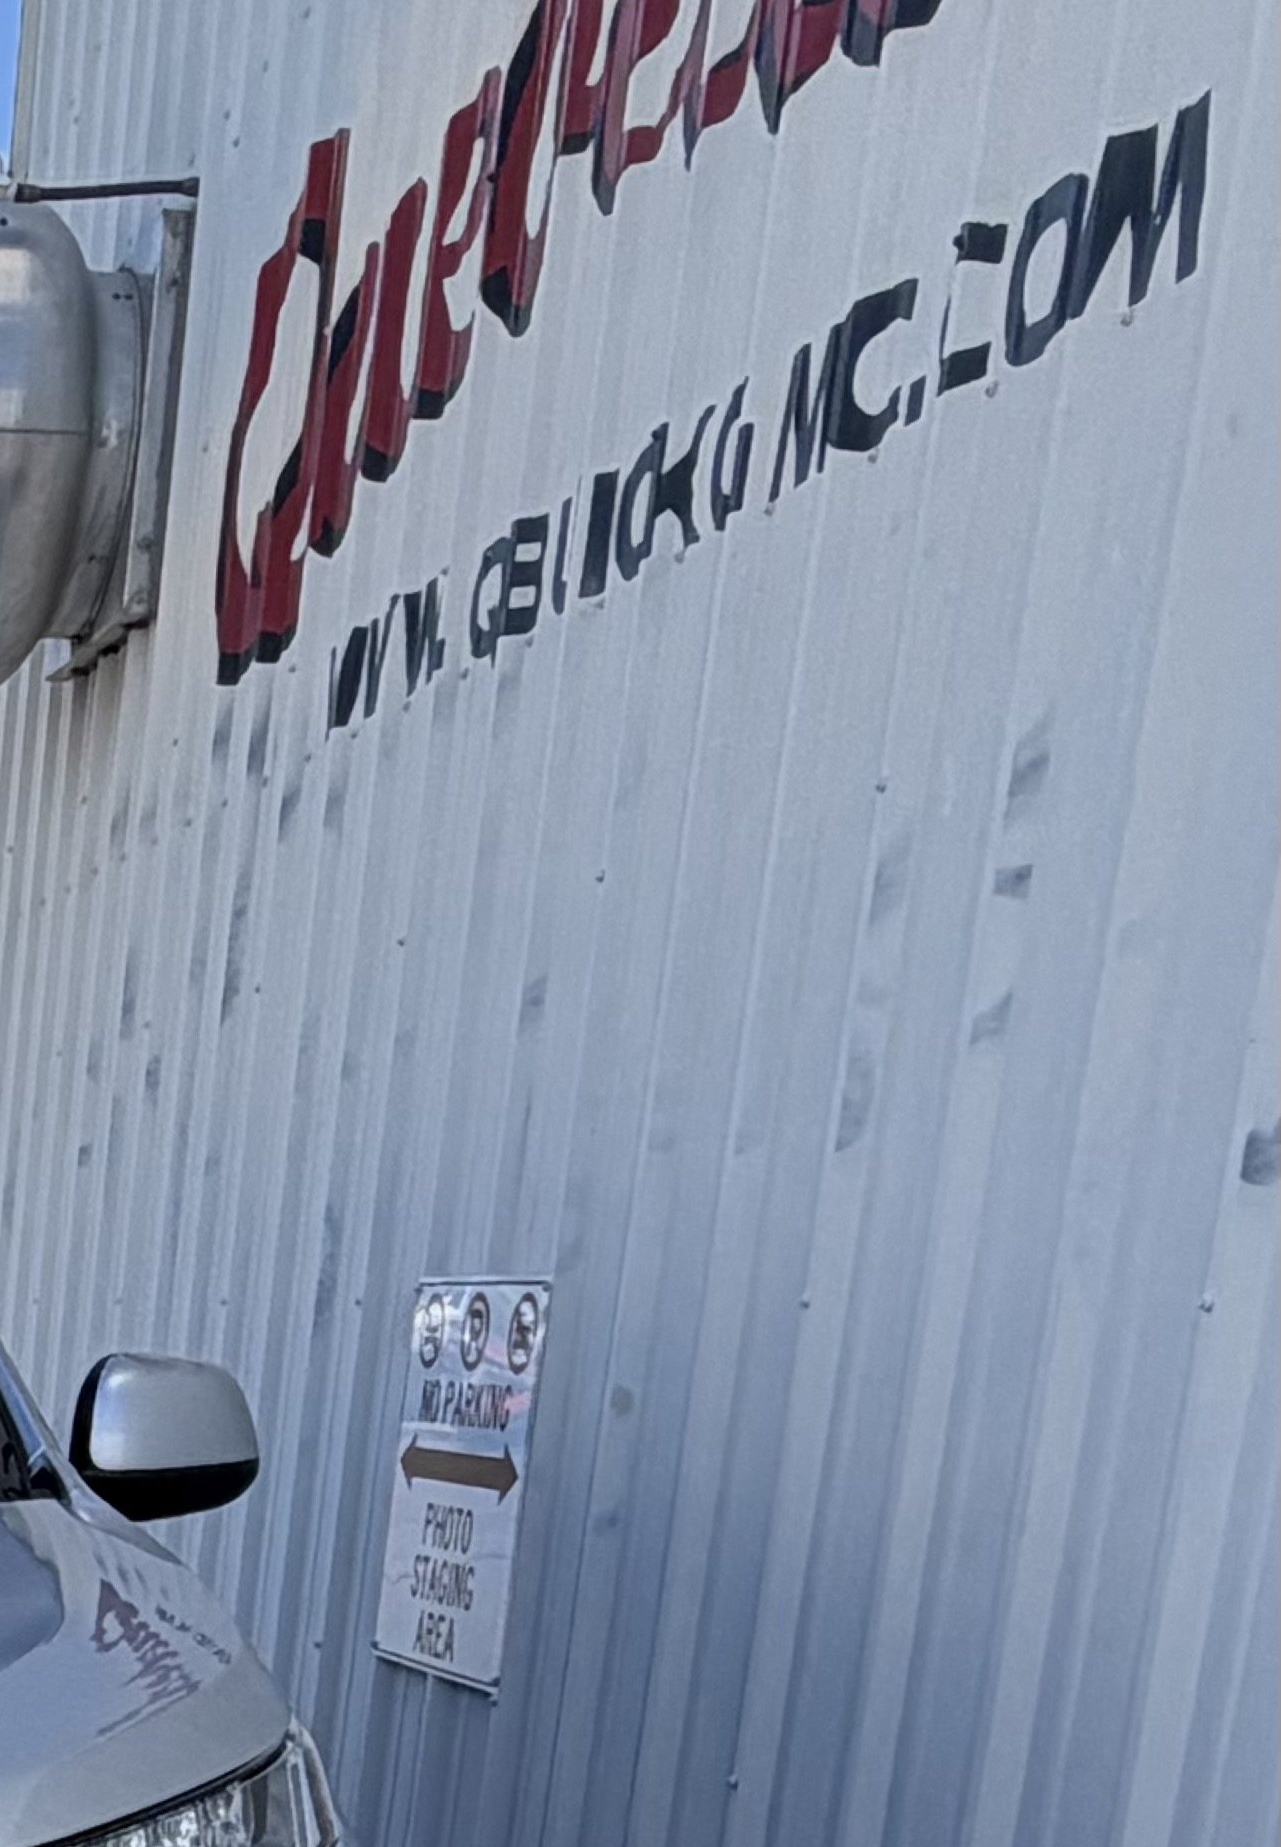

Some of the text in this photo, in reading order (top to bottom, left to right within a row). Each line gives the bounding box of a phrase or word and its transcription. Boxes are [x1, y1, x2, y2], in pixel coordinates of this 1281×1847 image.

[418, 1379, 513, 1432] NO PARKING
[422, 1502, 474, 1555] PHOTO
[410, 1553, 476, 1611] STAGING
[412, 1609, 455, 1663] AREA
